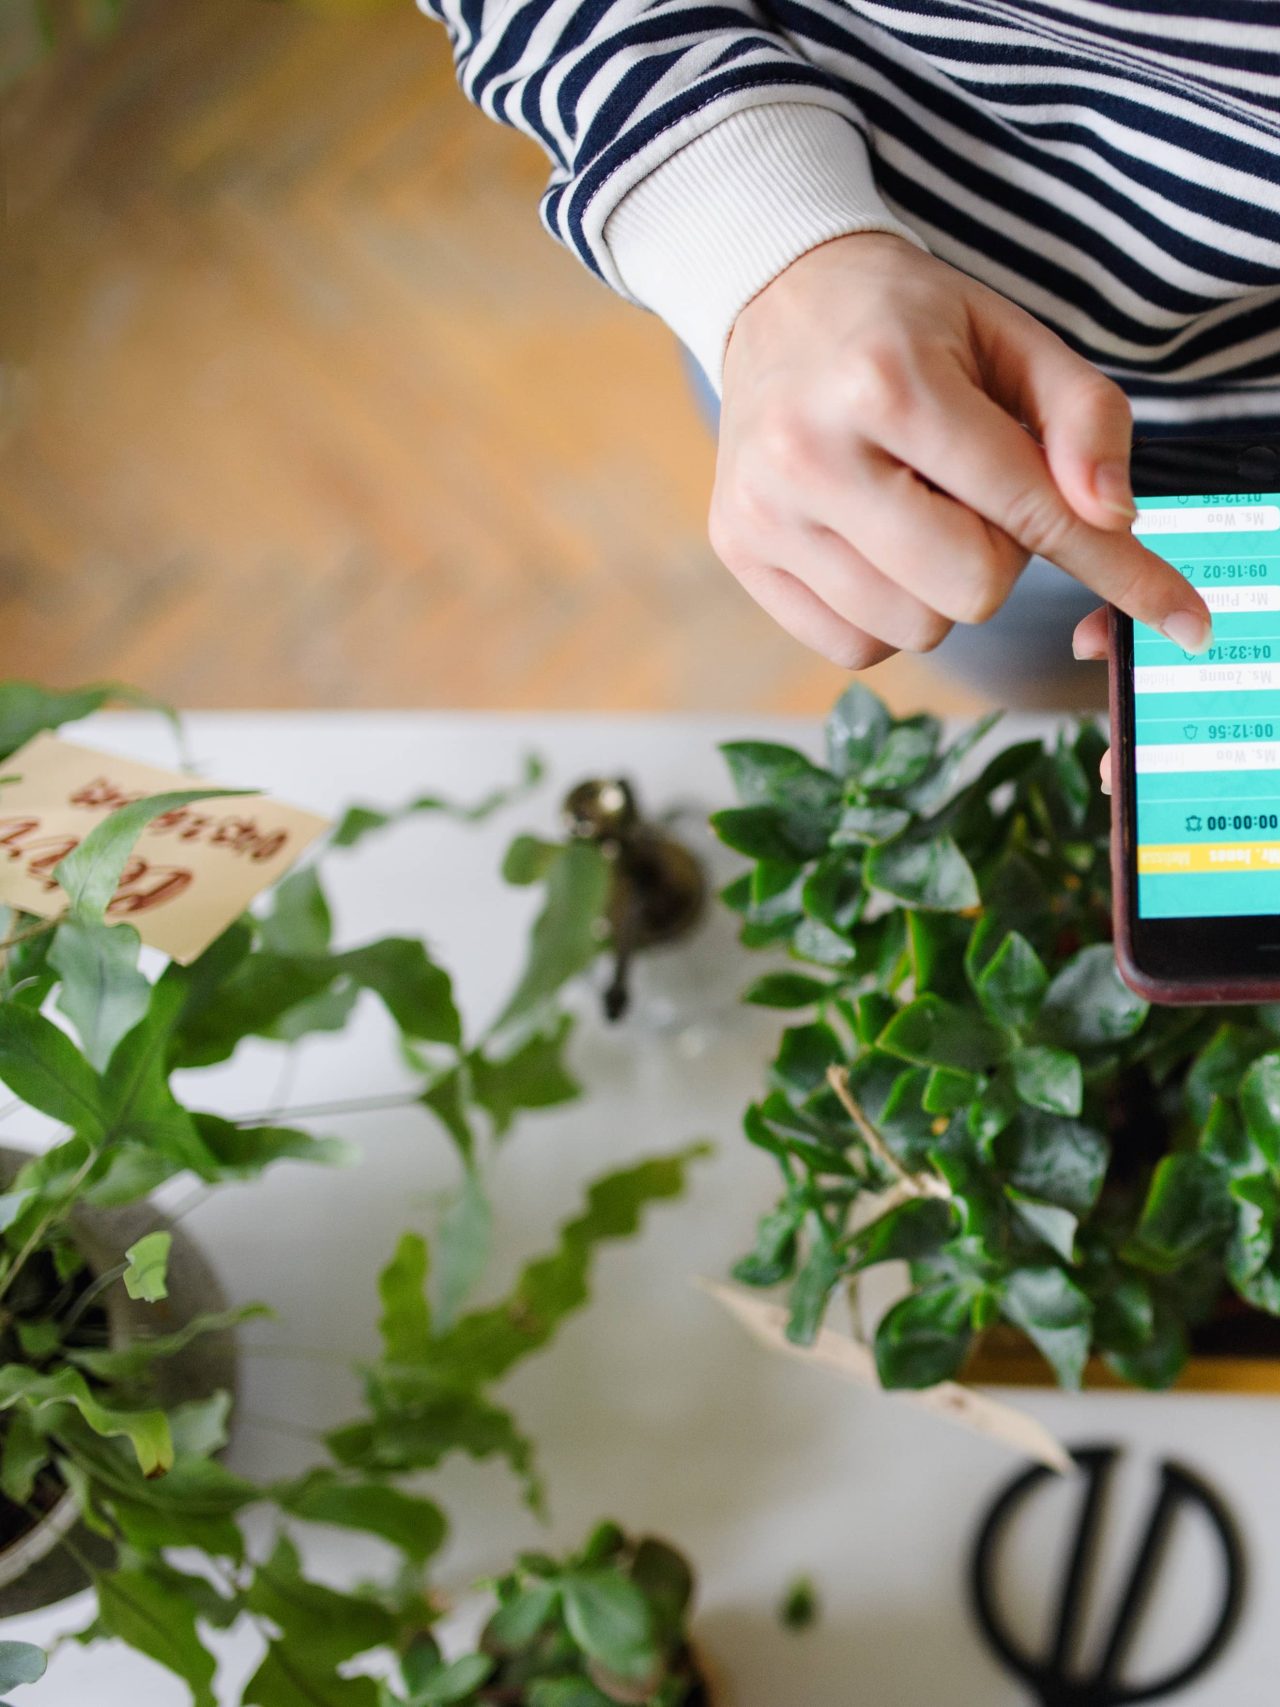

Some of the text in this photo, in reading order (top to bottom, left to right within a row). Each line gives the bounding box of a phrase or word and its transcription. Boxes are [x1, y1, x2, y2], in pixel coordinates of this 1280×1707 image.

[1207, 513, 1237, 525] Woo
[1241, 512, 1265, 525] Ms.
[1203, 564, 1267, 578] 09:16:02
[1203, 592, 1269, 606] Mr. Pilin
[1208, 645, 1271, 659] 04:32:14
[1247, 670, 1273, 684] Ms.
[1208, 724, 1273, 739] 00:12:56
[1216, 749, 1246, 763] Woo
[1251, 749, 1276, 763] Ms.
[1207, 815, 1278, 831] 00:00:00
[1209, 849, 1251, 865] Jones
